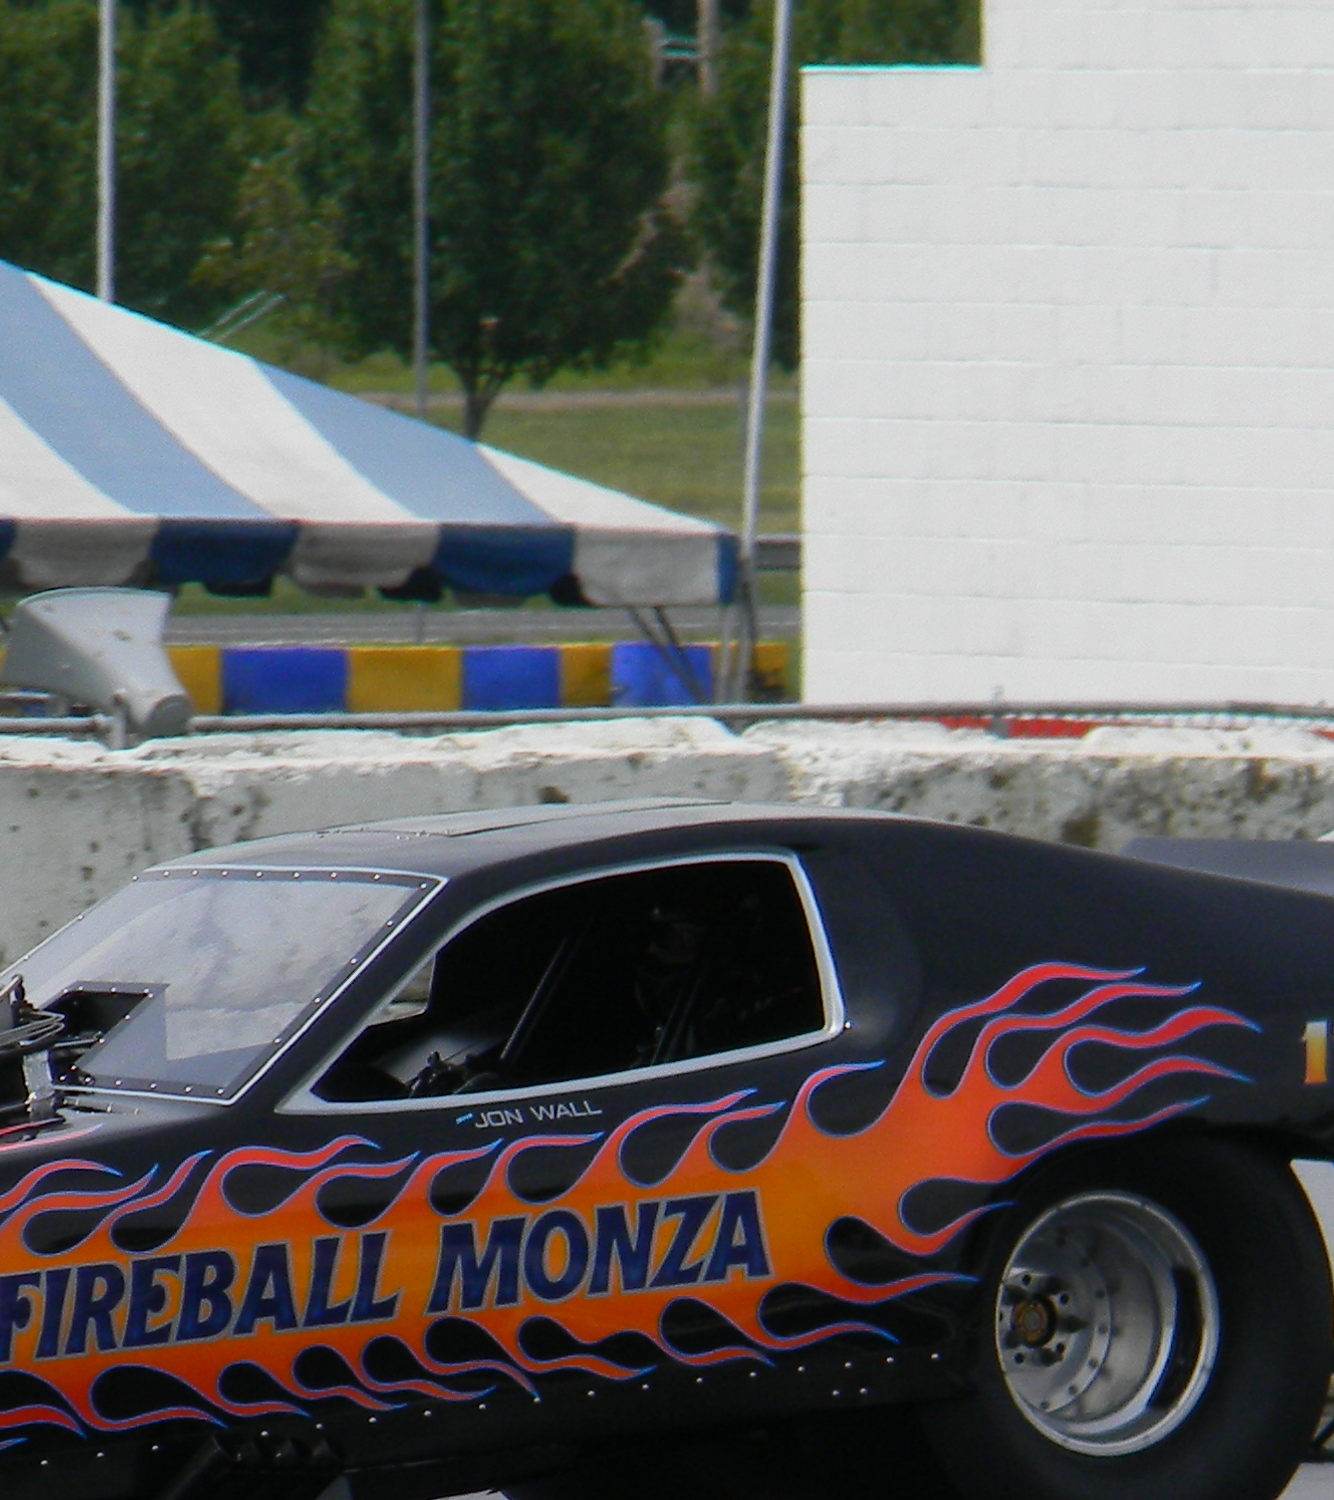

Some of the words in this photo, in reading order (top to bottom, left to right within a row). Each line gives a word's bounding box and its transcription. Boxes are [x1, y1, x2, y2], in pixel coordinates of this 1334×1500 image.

[474, 1108, 523, 1129] JON
[529, 1100, 603, 1121] WALL
[425, 1188, 773, 1317] MONZA
